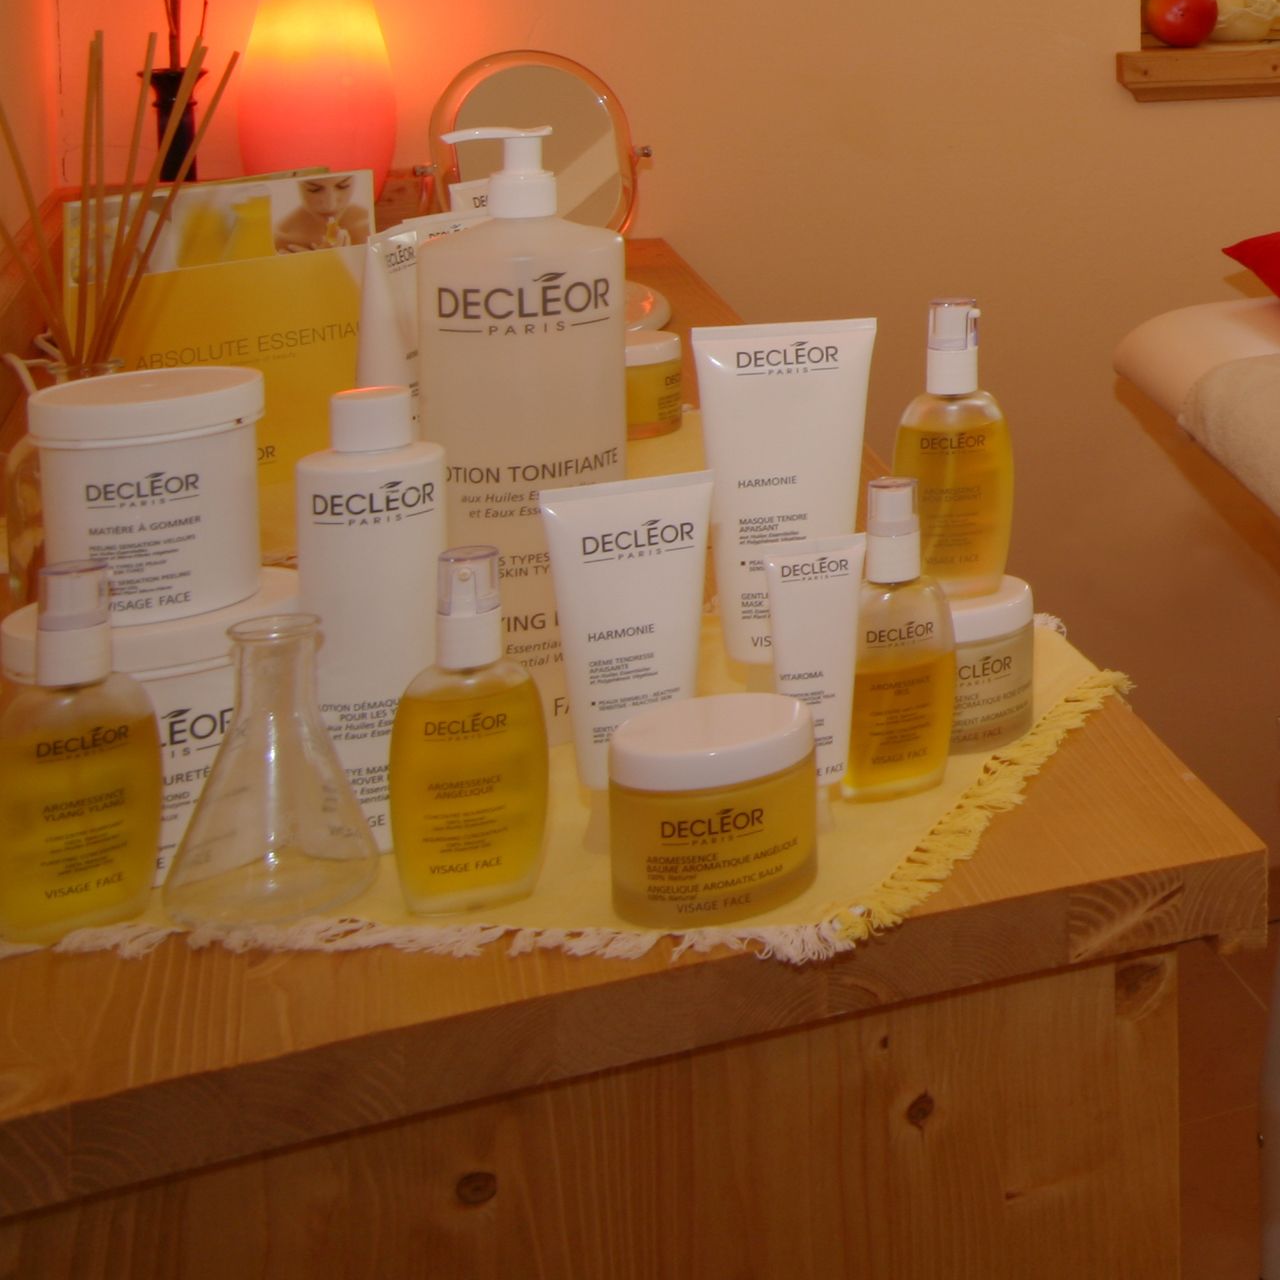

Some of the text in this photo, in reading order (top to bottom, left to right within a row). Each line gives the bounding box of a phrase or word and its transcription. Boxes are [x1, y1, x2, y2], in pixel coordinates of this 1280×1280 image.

[437, 271, 611, 321] DECLÉOR
[488, 320, 567, 337] PARIS
[135, 338, 250, 371] ABSOLUTE
[736, 340, 840, 370] DECLÉOR
[446, 446, 619, 486] TION TONIFIANTE
[85, 471, 201, 504] DECLÉOR
[737, 474, 799, 489] HARMONIE
[312, 480, 436, 516] DECLÉOR
[581, 518, 696, 557] DECLÉOR
[780, 557, 850, 579] DECLÉOR
[159, 591, 193, 607] FACE
[501, 612, 549, 634] ING
[587, 623, 656, 643] HARMONIE
[865, 620, 935, 645] DECLÉOR
[750, 636, 773, 648] VIS
[957, 655, 1014, 681] CLÉOR
[353, 697, 401, 714] DÉMAQU
[423, 712, 508, 738] DECLÉOR
[34, 724, 131, 760] DECLÉOR
[162, 765, 212, 787] URETÉ
[660, 807, 765, 840] DECLÉOR
[429, 855, 504, 876] VISAGE FACE
[43, 871, 125, 900] VISAGE FACE
[702, 872, 757, 892] AROMATIC
[676, 891, 754, 915] VISAGE FACE
